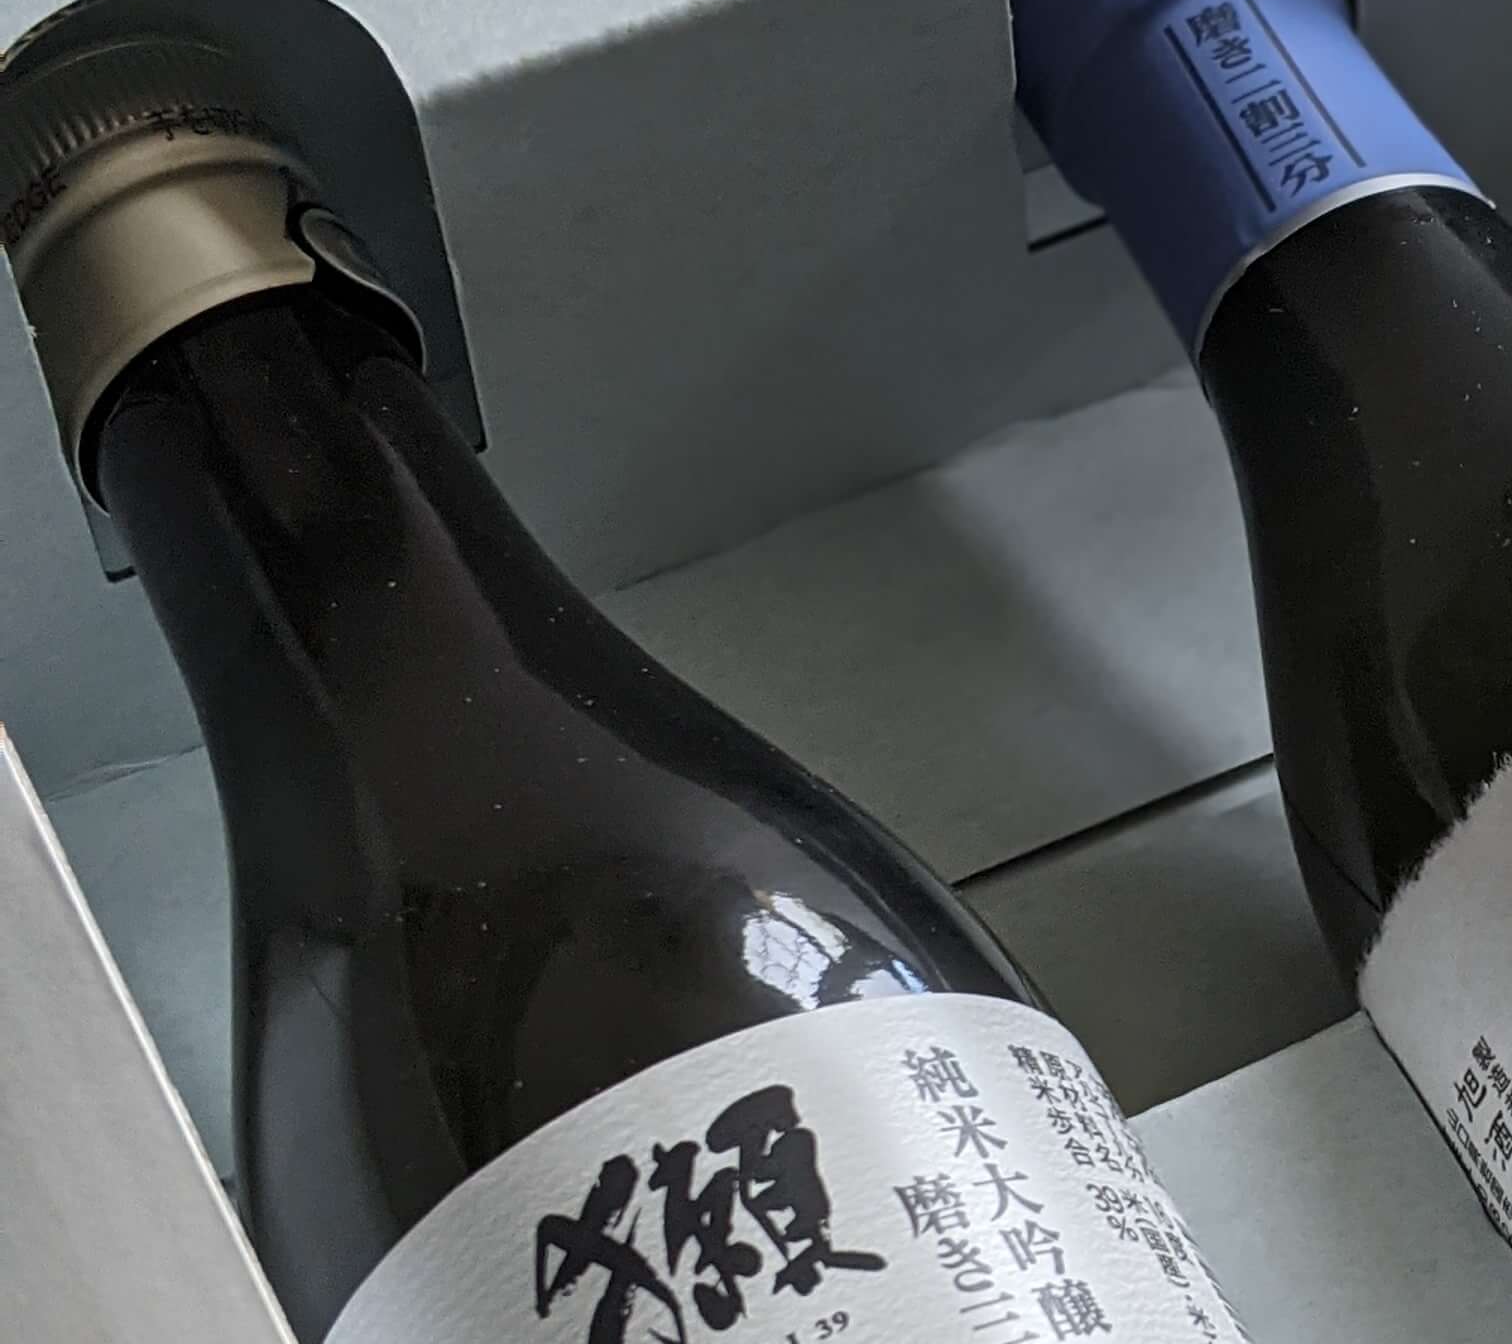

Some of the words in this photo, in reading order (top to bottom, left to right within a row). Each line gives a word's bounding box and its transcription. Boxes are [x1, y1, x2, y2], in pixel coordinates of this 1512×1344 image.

[1185, 2, 1335, 197] 磨き二割三分
[902, 1045, 1113, 1341] 純米大吟醸
[1007, 1043, 1096, 1168] 精米歩合
[1084, 1182, 1140, 1243] 39%
[814, 1310, 852, 1342] 39
